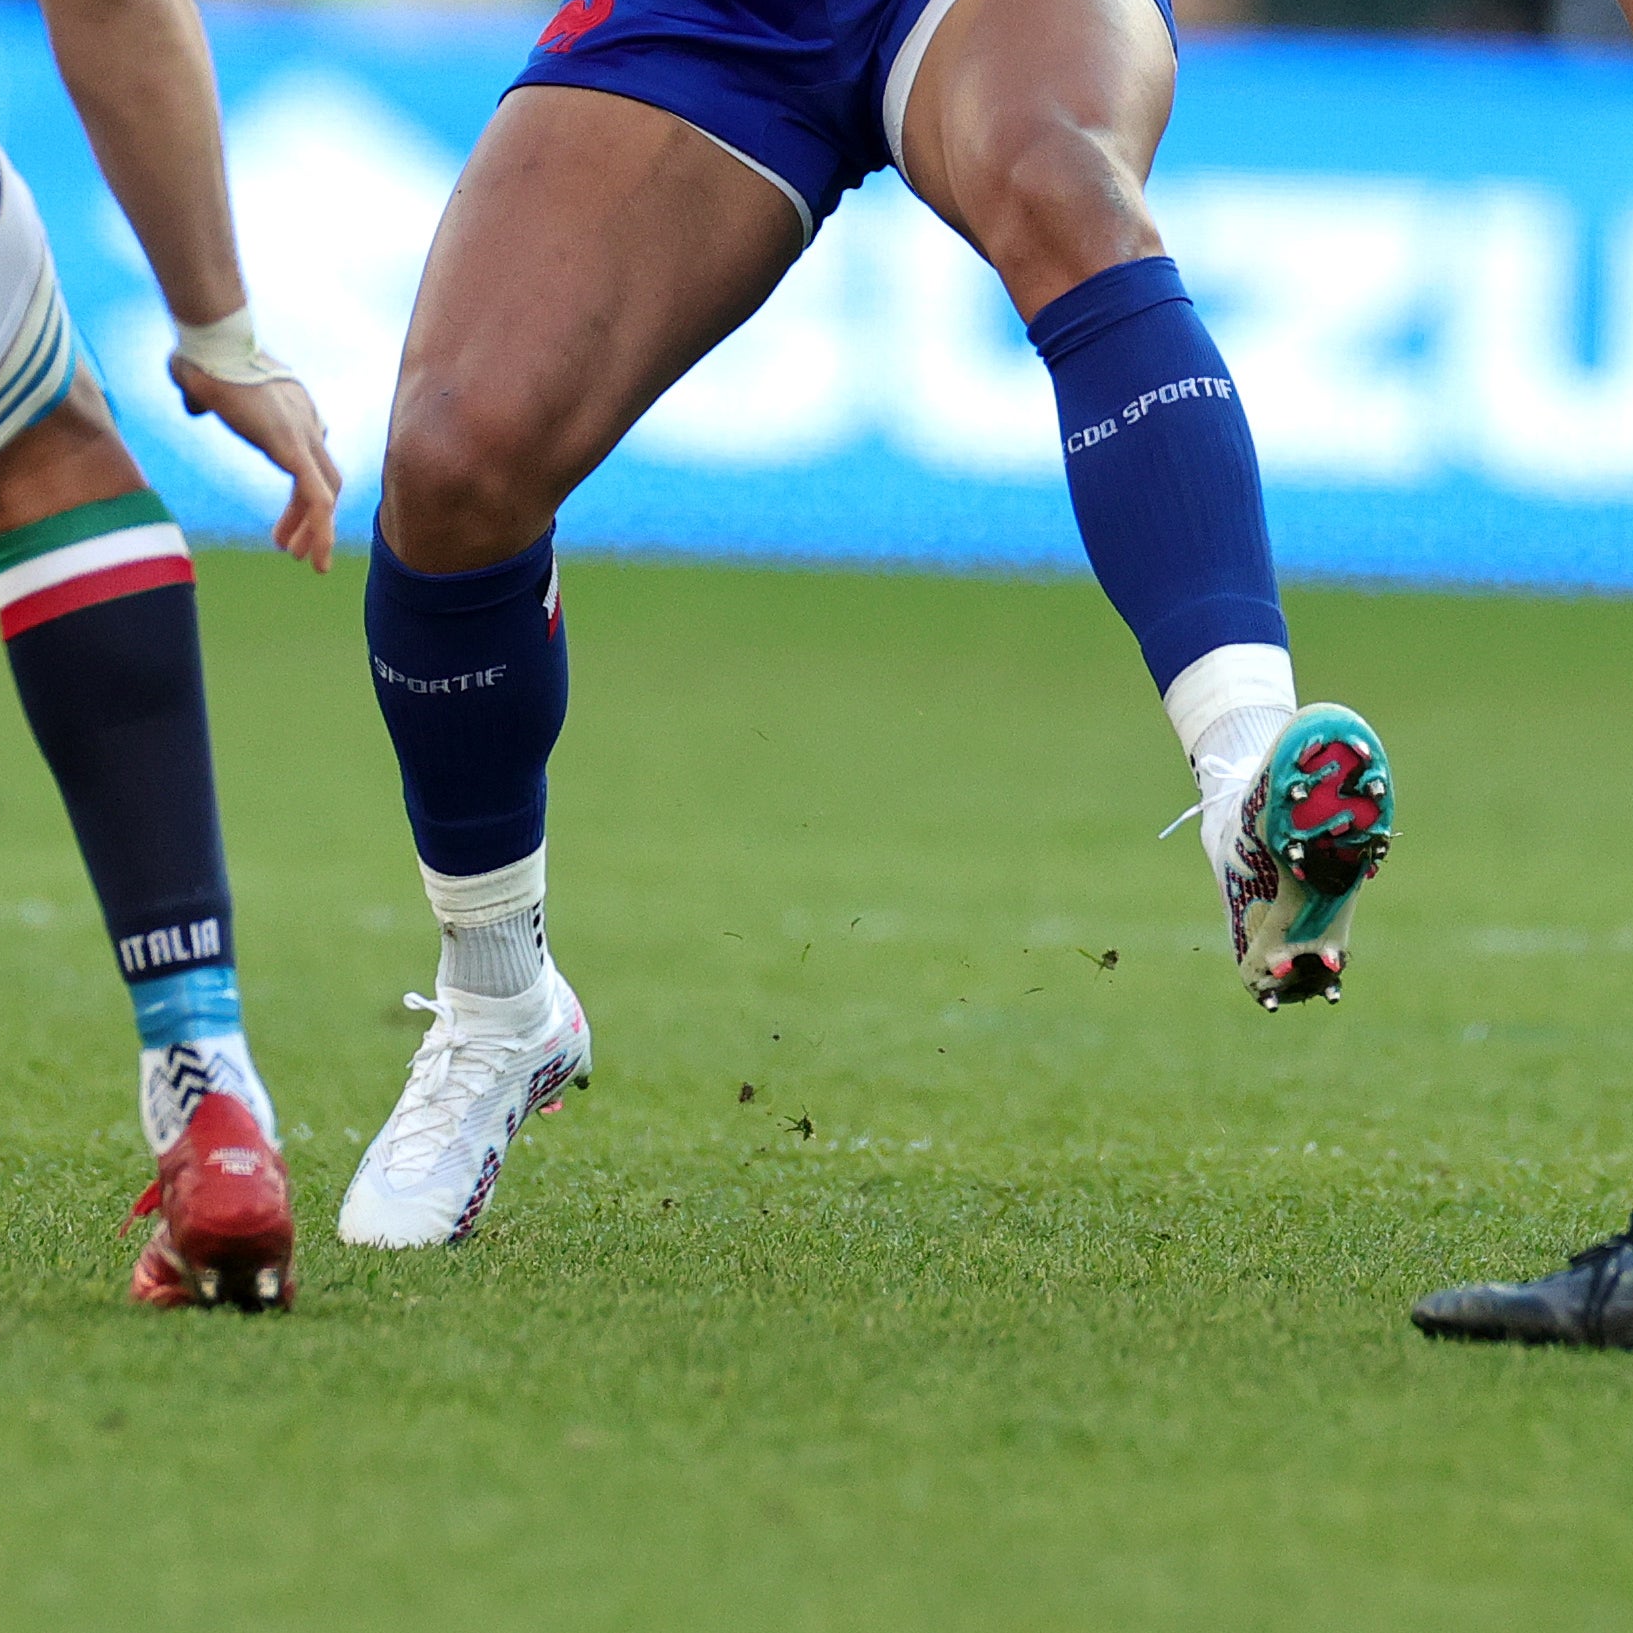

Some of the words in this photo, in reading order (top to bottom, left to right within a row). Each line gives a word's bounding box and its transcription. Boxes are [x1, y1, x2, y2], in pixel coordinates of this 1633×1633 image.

[1122, 376, 1233, 425] SPORTIF
[374, 654, 507, 694] SPORTIF
[119, 917, 220, 973] ITALIA
